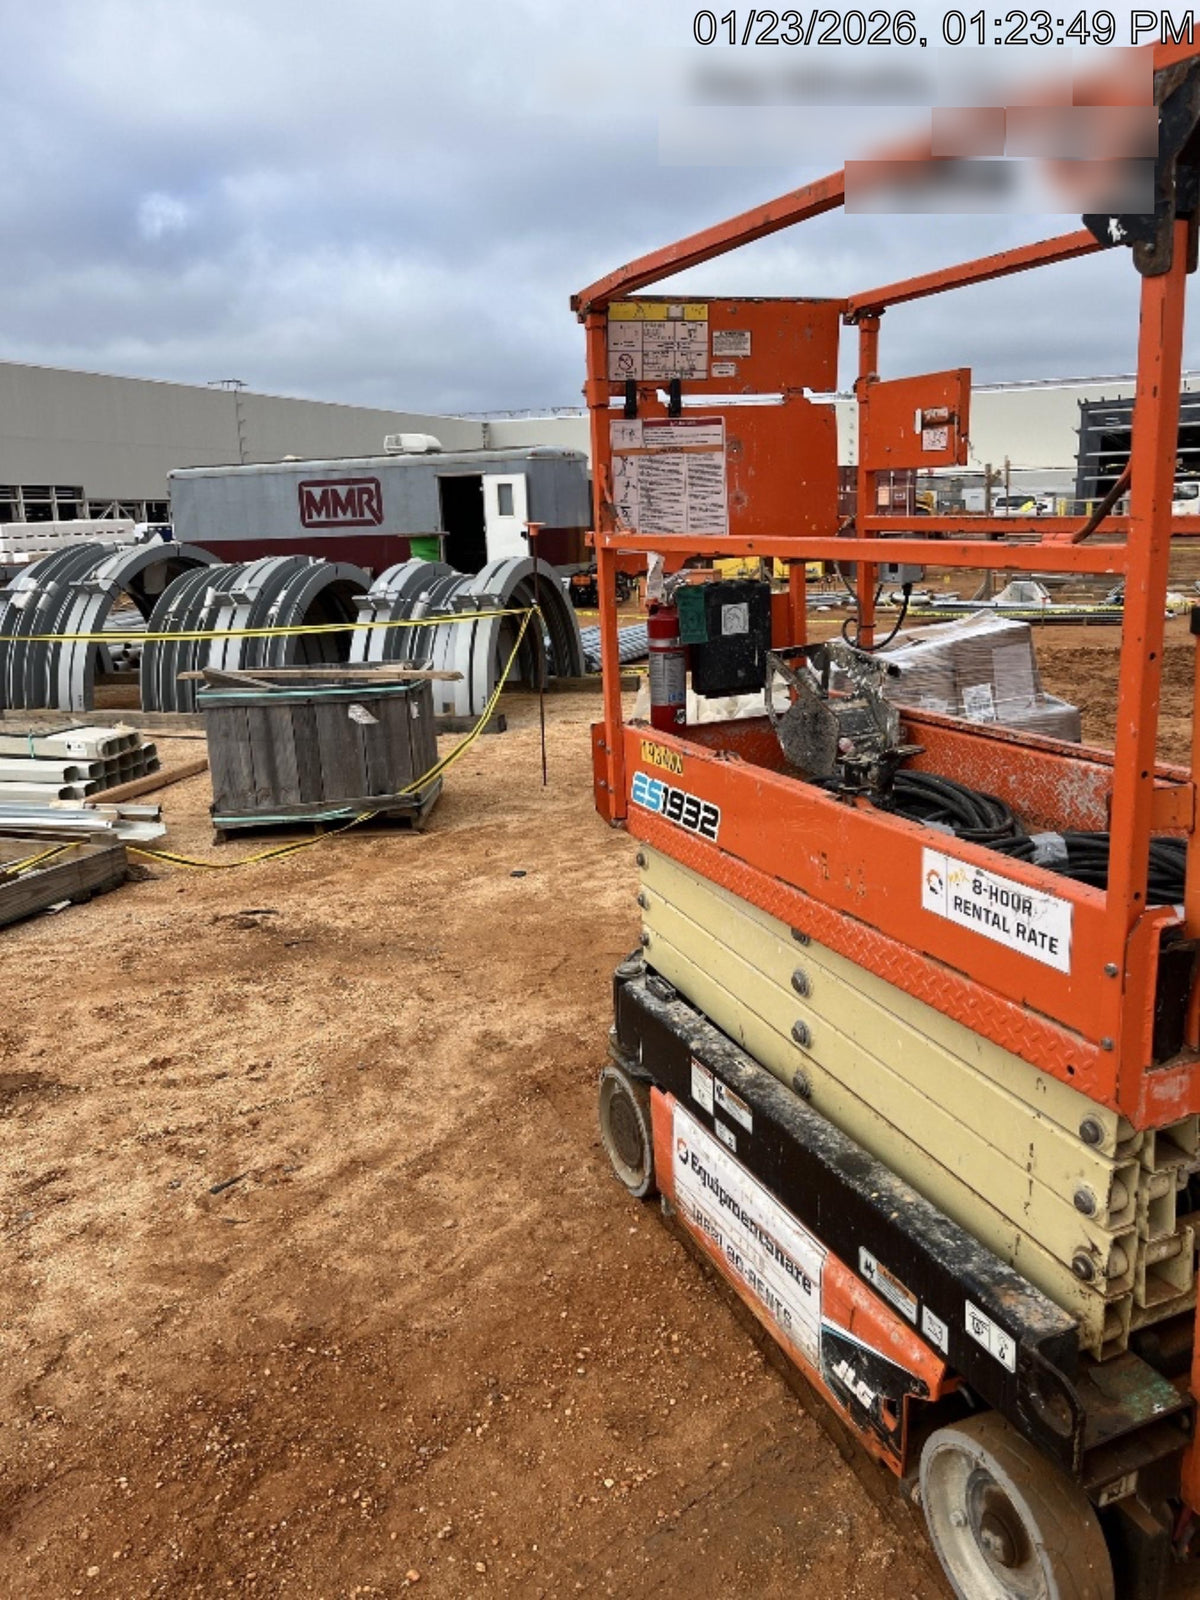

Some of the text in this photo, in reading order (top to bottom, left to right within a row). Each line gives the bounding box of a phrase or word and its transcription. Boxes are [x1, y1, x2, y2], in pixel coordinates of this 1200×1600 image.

[305, 487, 382, 525] MMR
[632, 773, 720, 841] ES1932
[972, 878, 1032, 917] 8-HOUR
[954, 895, 1059, 955] RENTAL RATE
[831, 1360, 876, 1410] JLG
